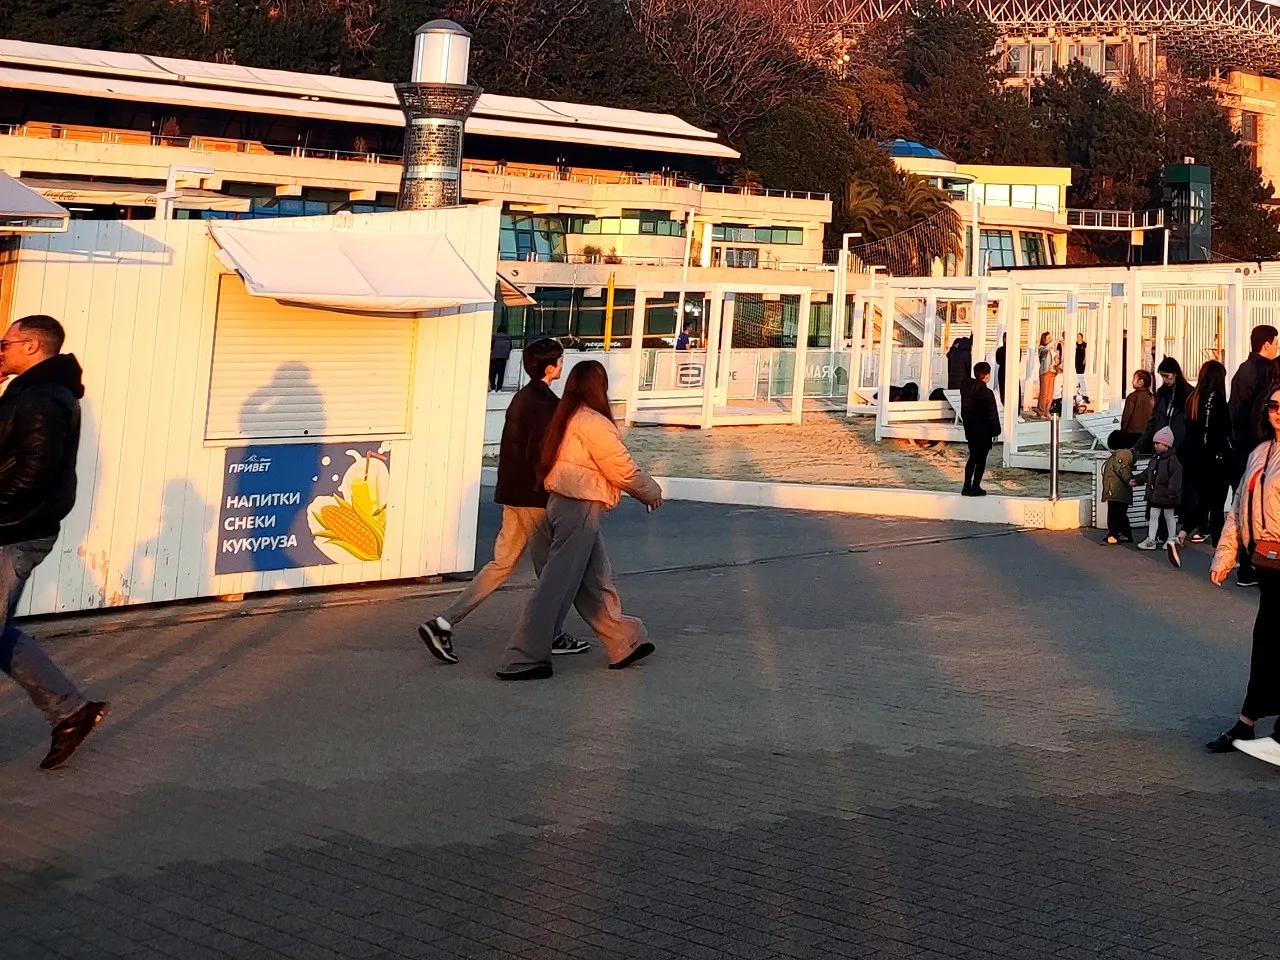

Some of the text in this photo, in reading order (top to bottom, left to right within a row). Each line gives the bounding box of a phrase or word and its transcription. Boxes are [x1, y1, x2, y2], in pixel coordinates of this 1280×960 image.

[228, 462, 272, 474] ПРИВЕТ
[226, 492, 301, 509] НАПИТКИ
[224, 515, 276, 531] СНЕКИ
[222, 534, 298, 554] КУКУРУЗА
